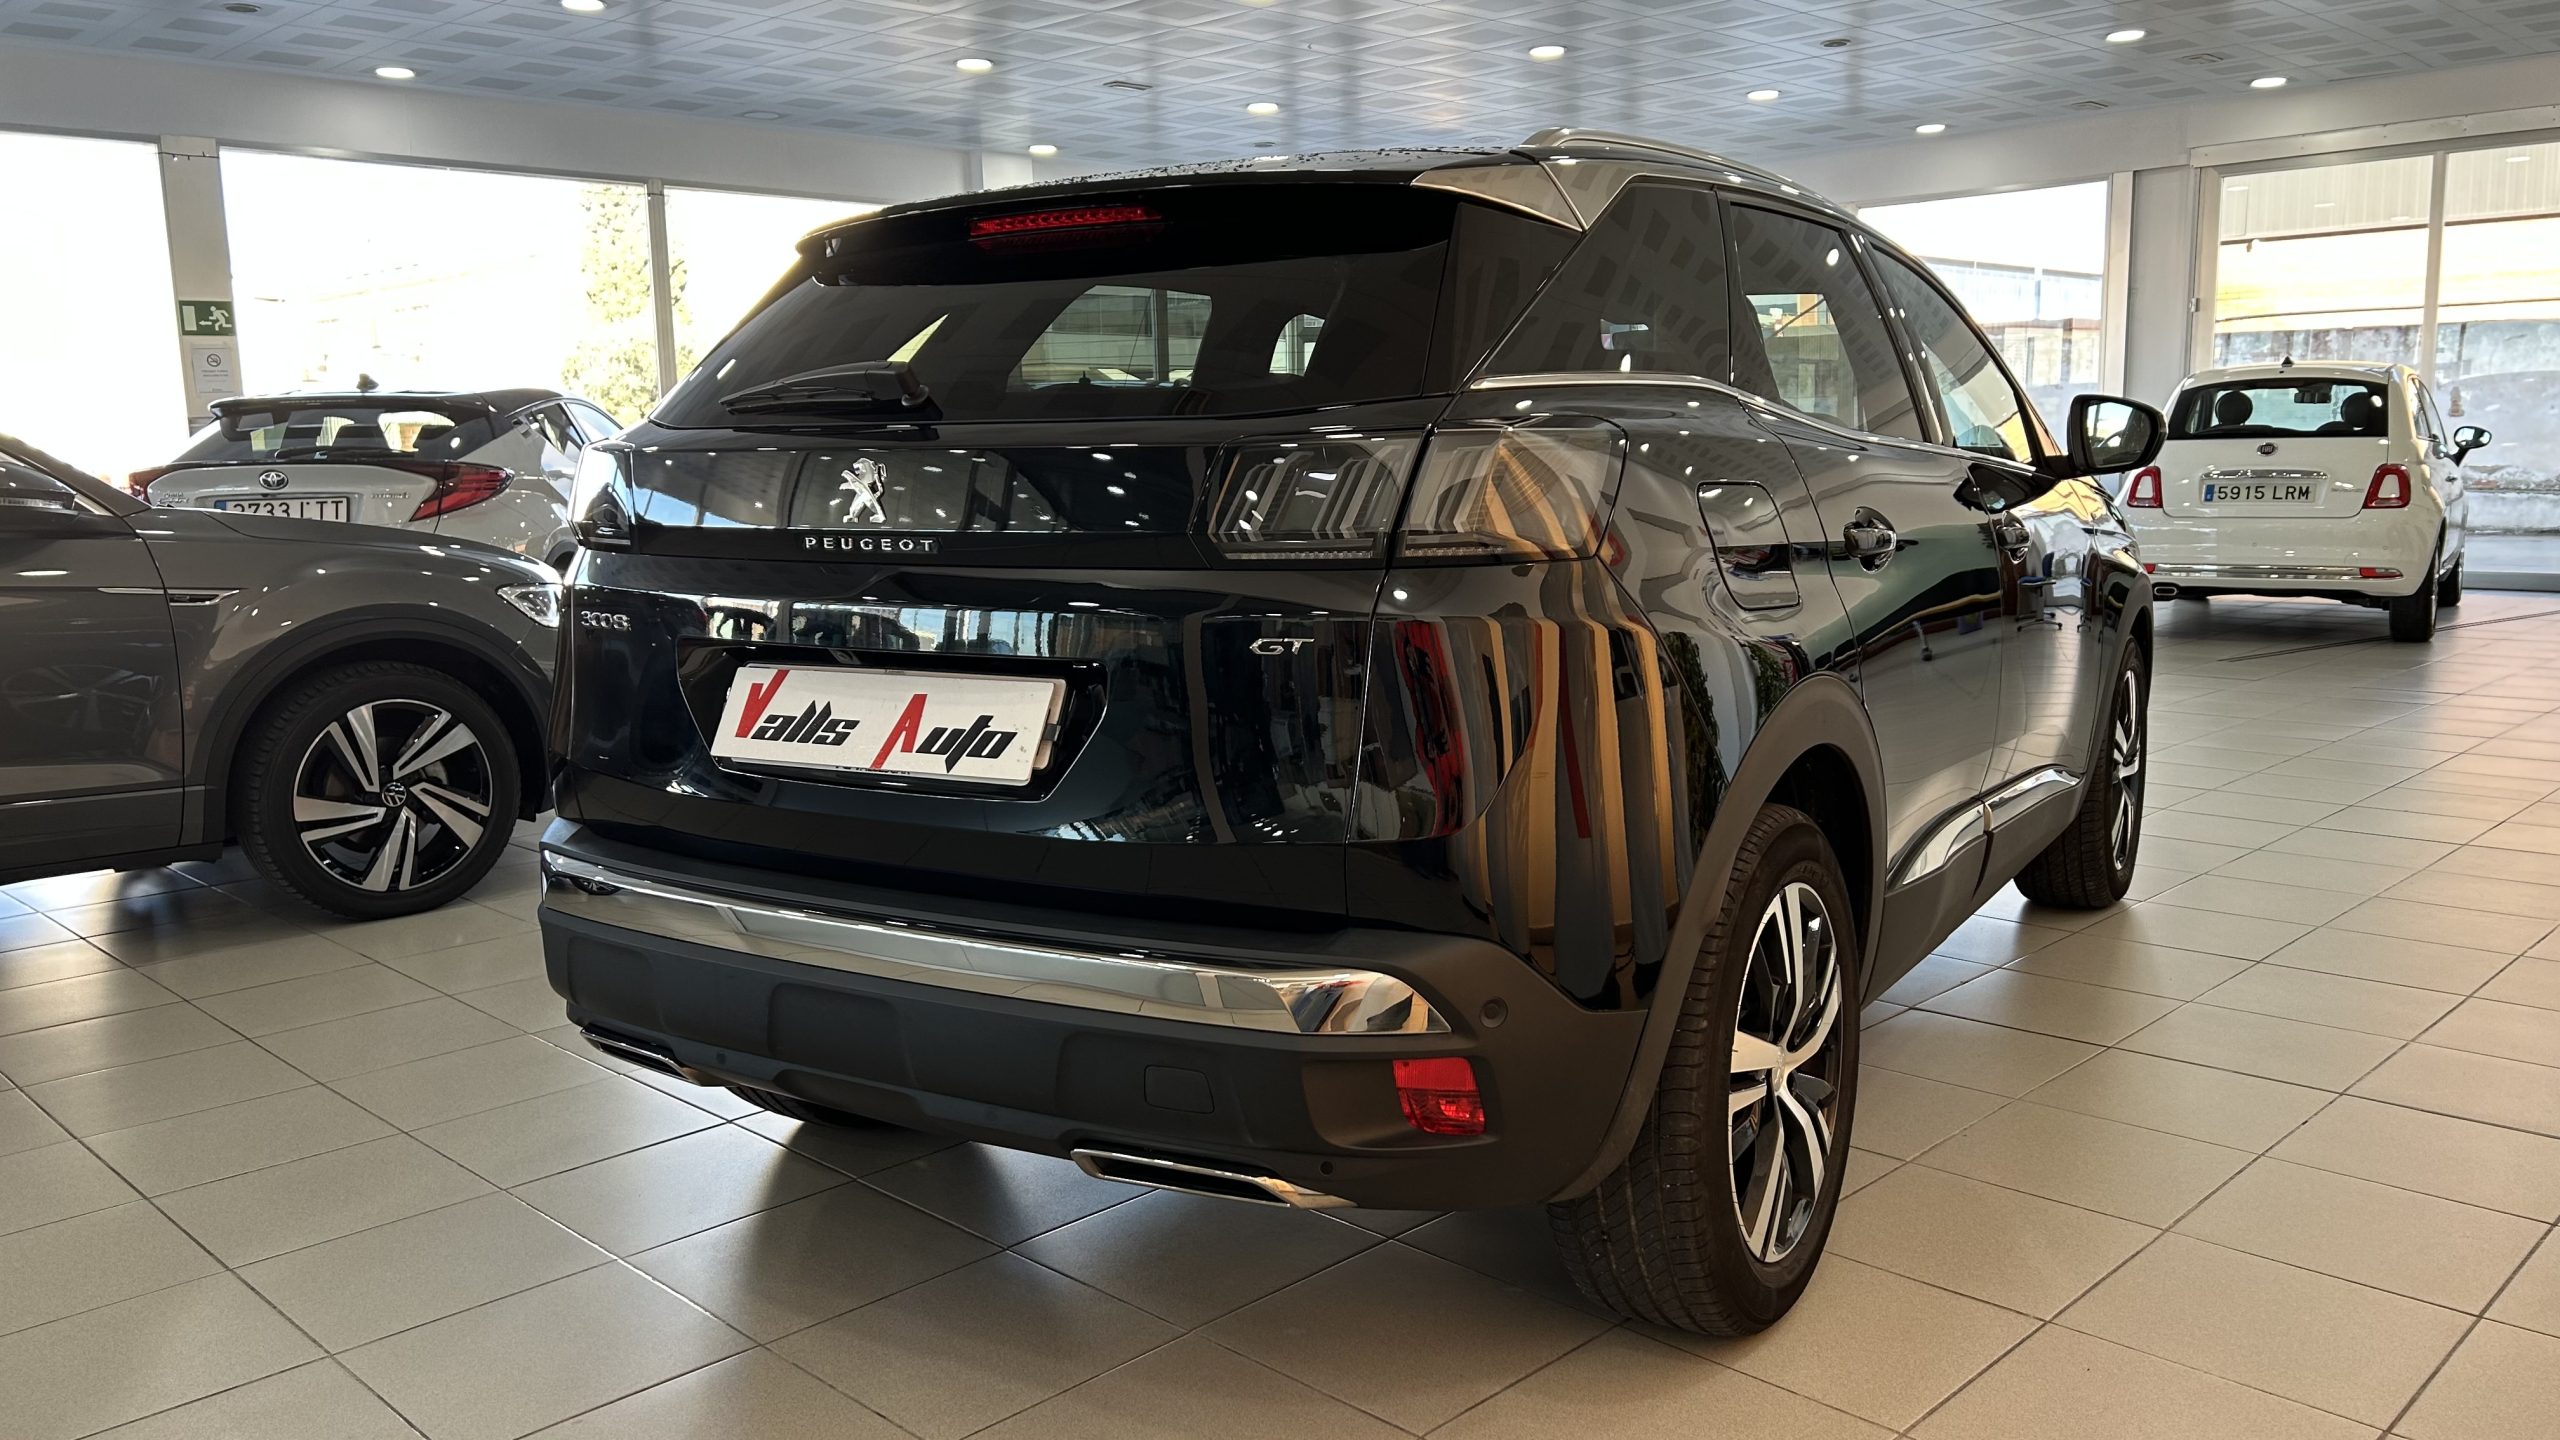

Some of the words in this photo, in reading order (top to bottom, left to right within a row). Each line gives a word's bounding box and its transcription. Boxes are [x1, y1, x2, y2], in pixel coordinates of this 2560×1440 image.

[2217, 486, 2265, 500] 5915
[2272, 485, 2311, 501] LRM
[804, 536, 934, 552] PEUGEOT
[1249, 637, 1315, 655] GT
[735, 669, 860, 746] Valls
[869, 693, 1018, 773] Auto
